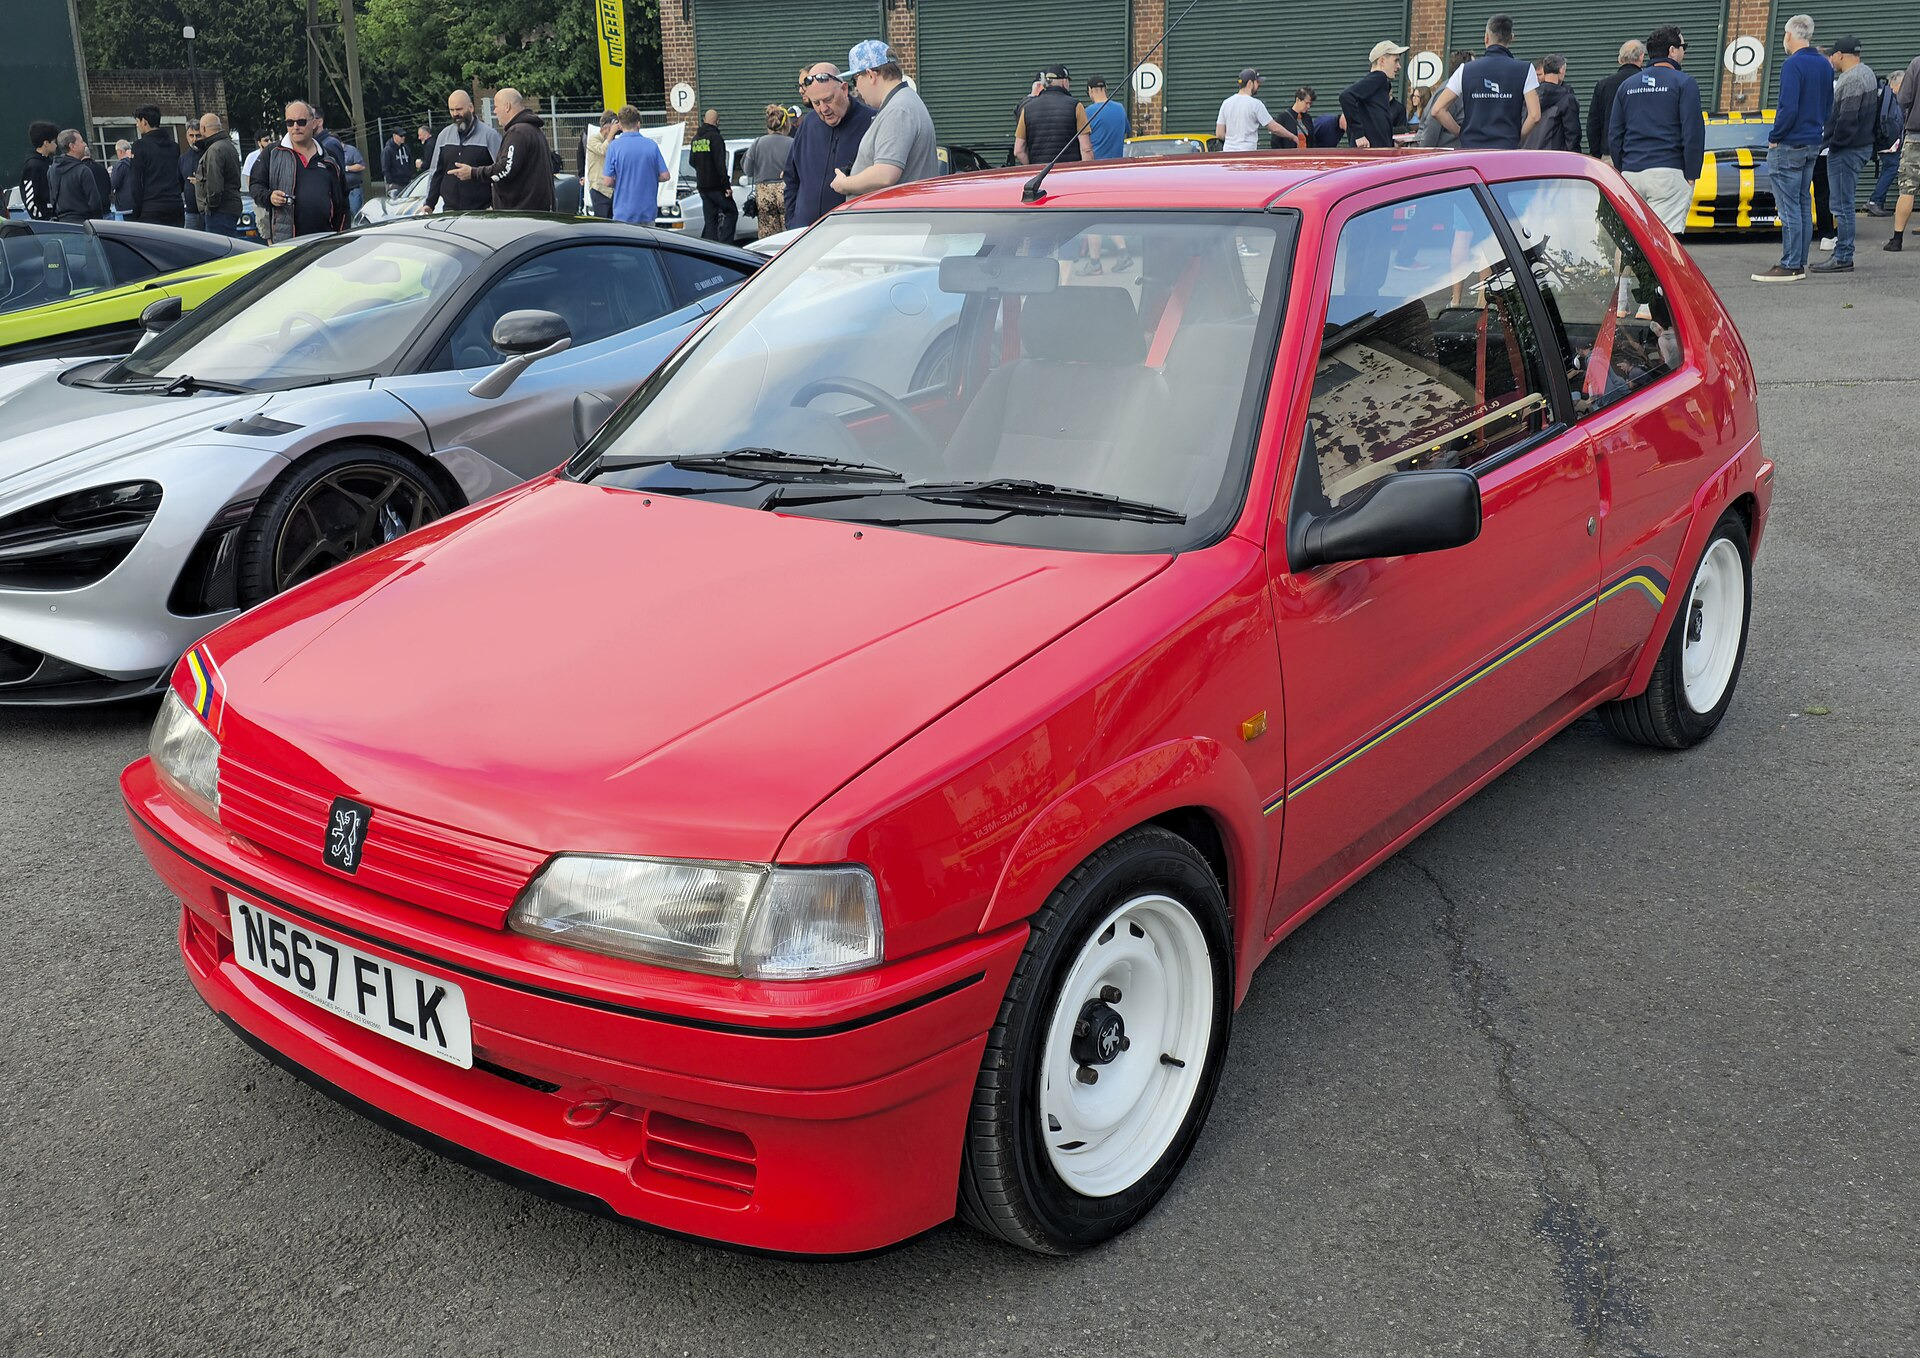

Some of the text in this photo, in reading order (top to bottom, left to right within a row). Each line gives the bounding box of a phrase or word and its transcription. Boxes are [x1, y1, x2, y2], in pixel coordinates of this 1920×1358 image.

[606, 35, 623, 66] RUN
[1417, 60, 1435, 80] D
[1140, 71, 1156, 90] D
[678, 90, 688, 107] P
[243, 910, 448, 1049] N567 FLK
